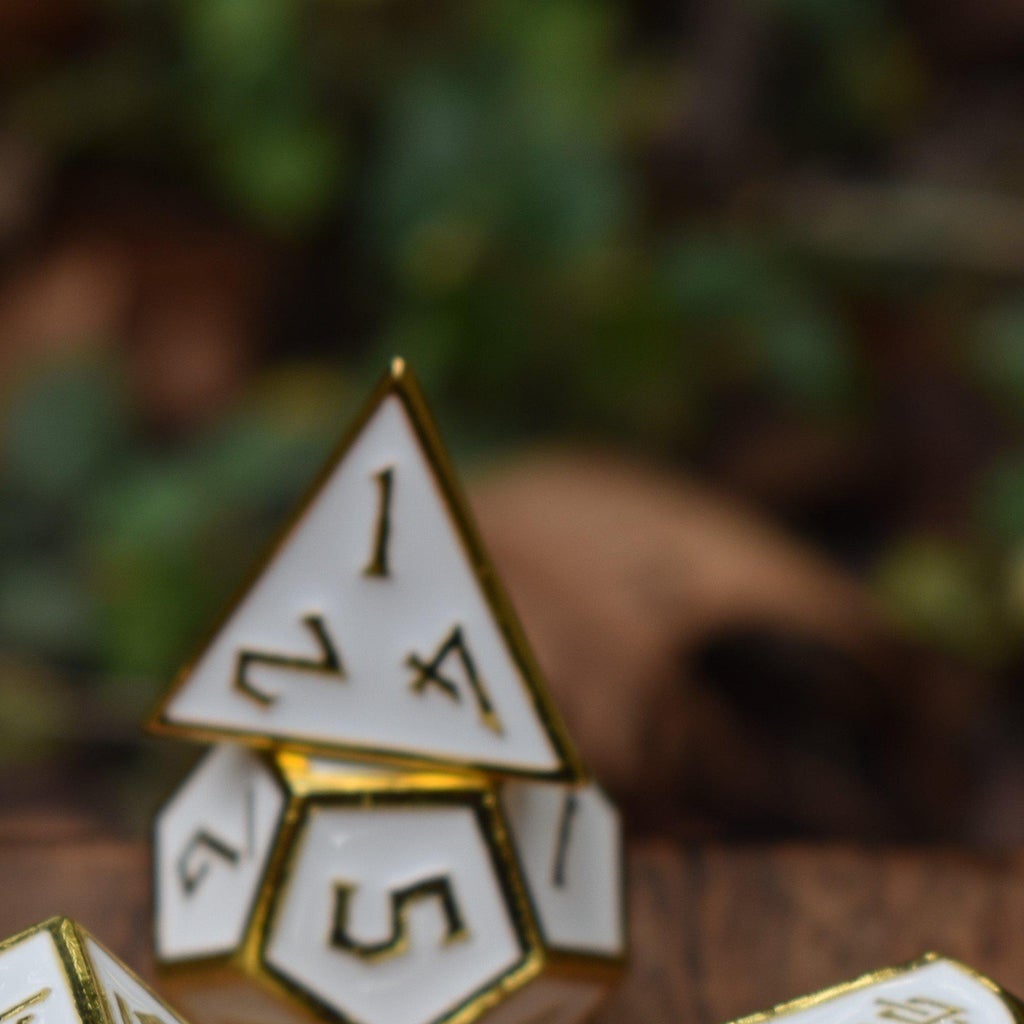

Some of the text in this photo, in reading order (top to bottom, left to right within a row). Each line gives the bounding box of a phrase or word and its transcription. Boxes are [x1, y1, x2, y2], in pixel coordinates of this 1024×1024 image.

[362, 465, 395, 578] 1
[232, 609, 347, 711] 2
[404, 624, 504, 737] 4
